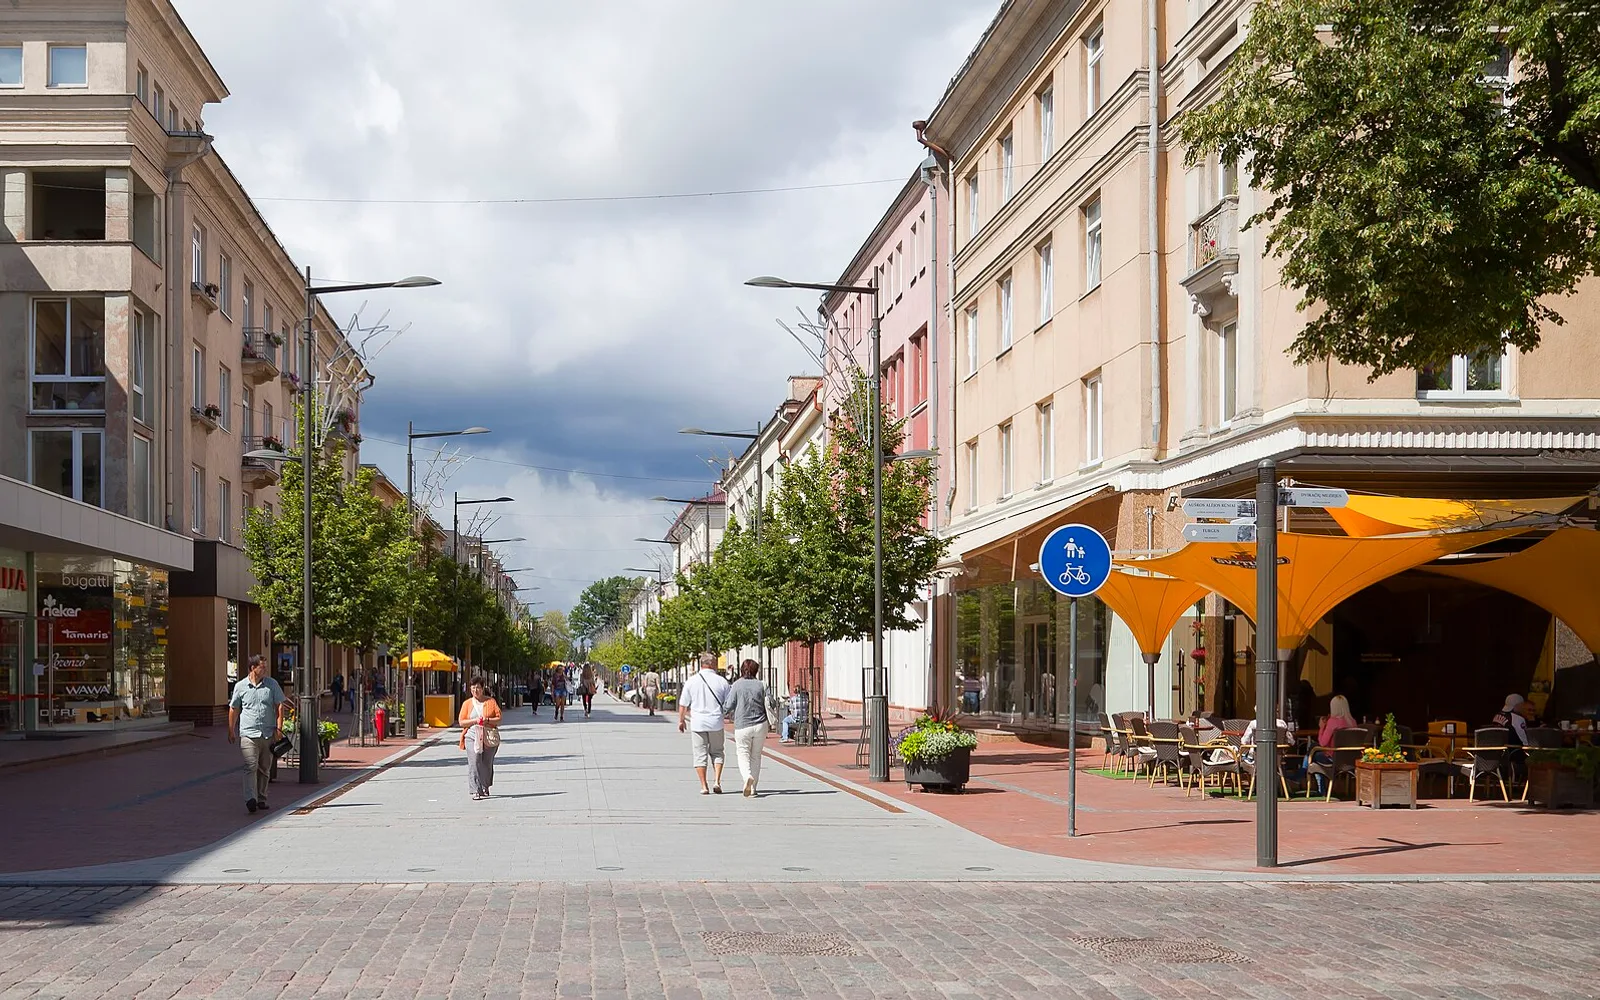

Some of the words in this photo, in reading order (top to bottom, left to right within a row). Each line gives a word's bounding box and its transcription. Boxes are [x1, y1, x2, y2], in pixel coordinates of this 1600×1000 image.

[62, 573, 109, 590] bugatti
[42, 600, 82, 617] rieker
[61, 629, 109, 639] tamaris
[65, 685, 110, 695] WAWA
